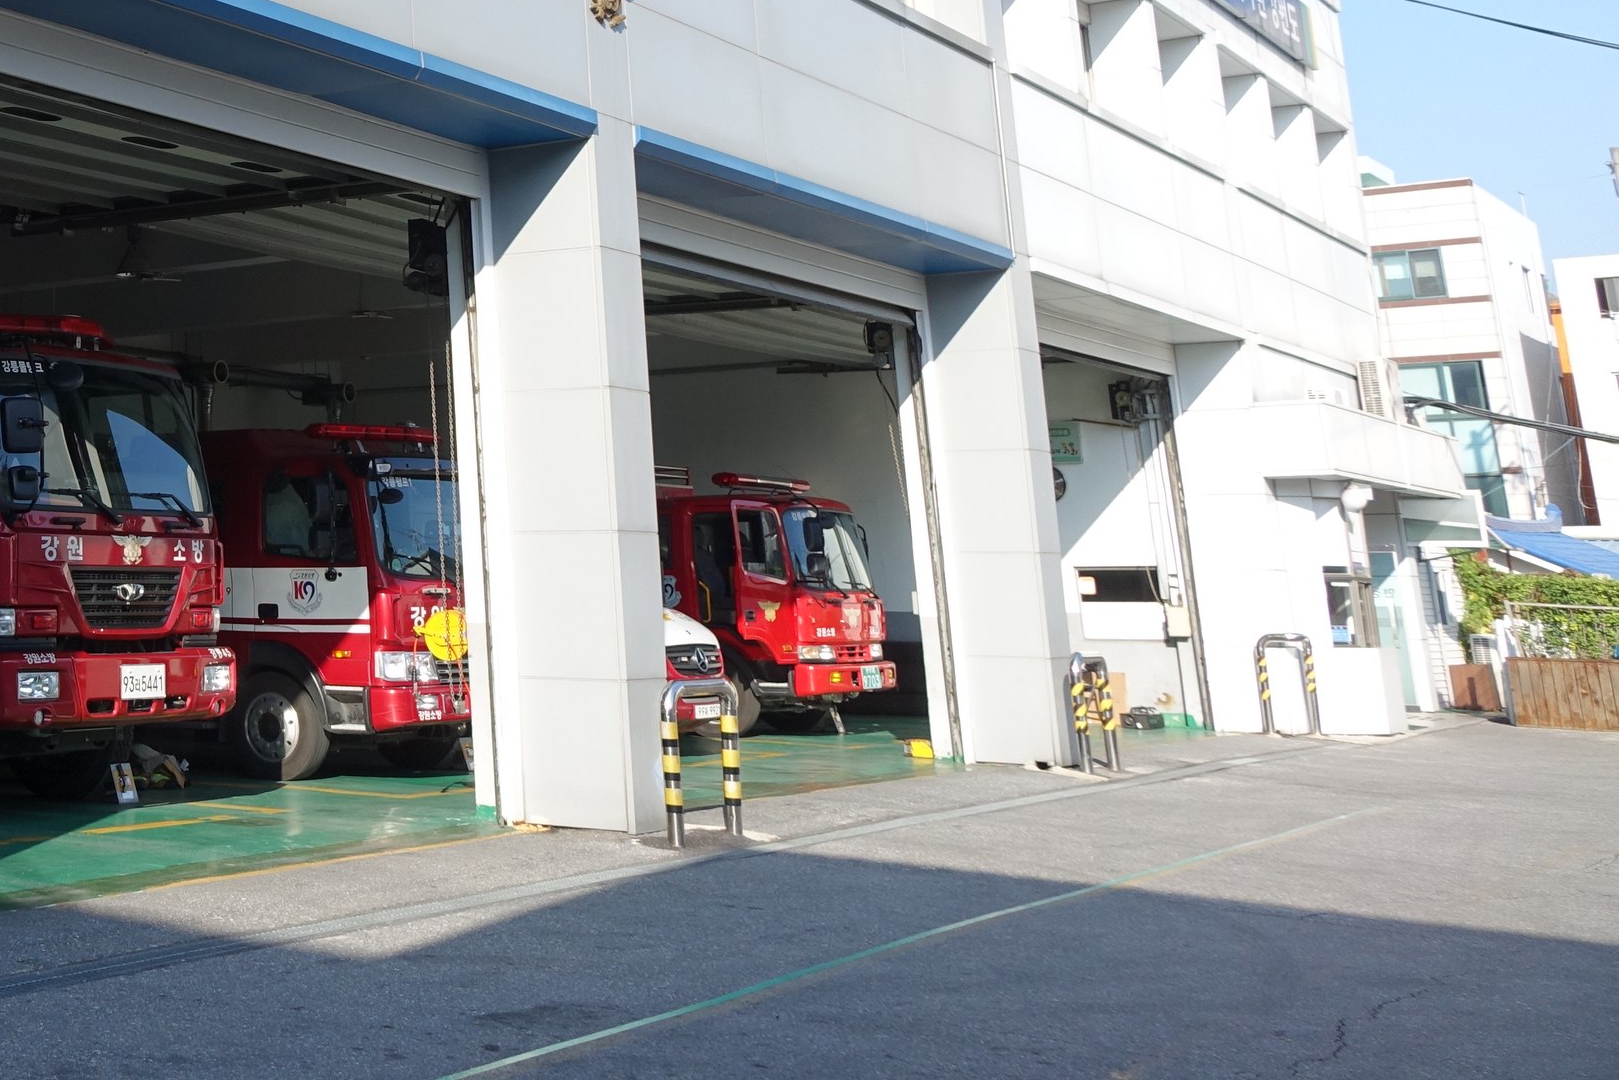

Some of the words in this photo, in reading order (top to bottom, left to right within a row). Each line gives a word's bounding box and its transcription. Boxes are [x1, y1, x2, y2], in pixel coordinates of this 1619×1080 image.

[40, 535, 84, 562] 강원
[173, 538, 205, 564] 소방
[22, 652, 56, 664] 강원소방
